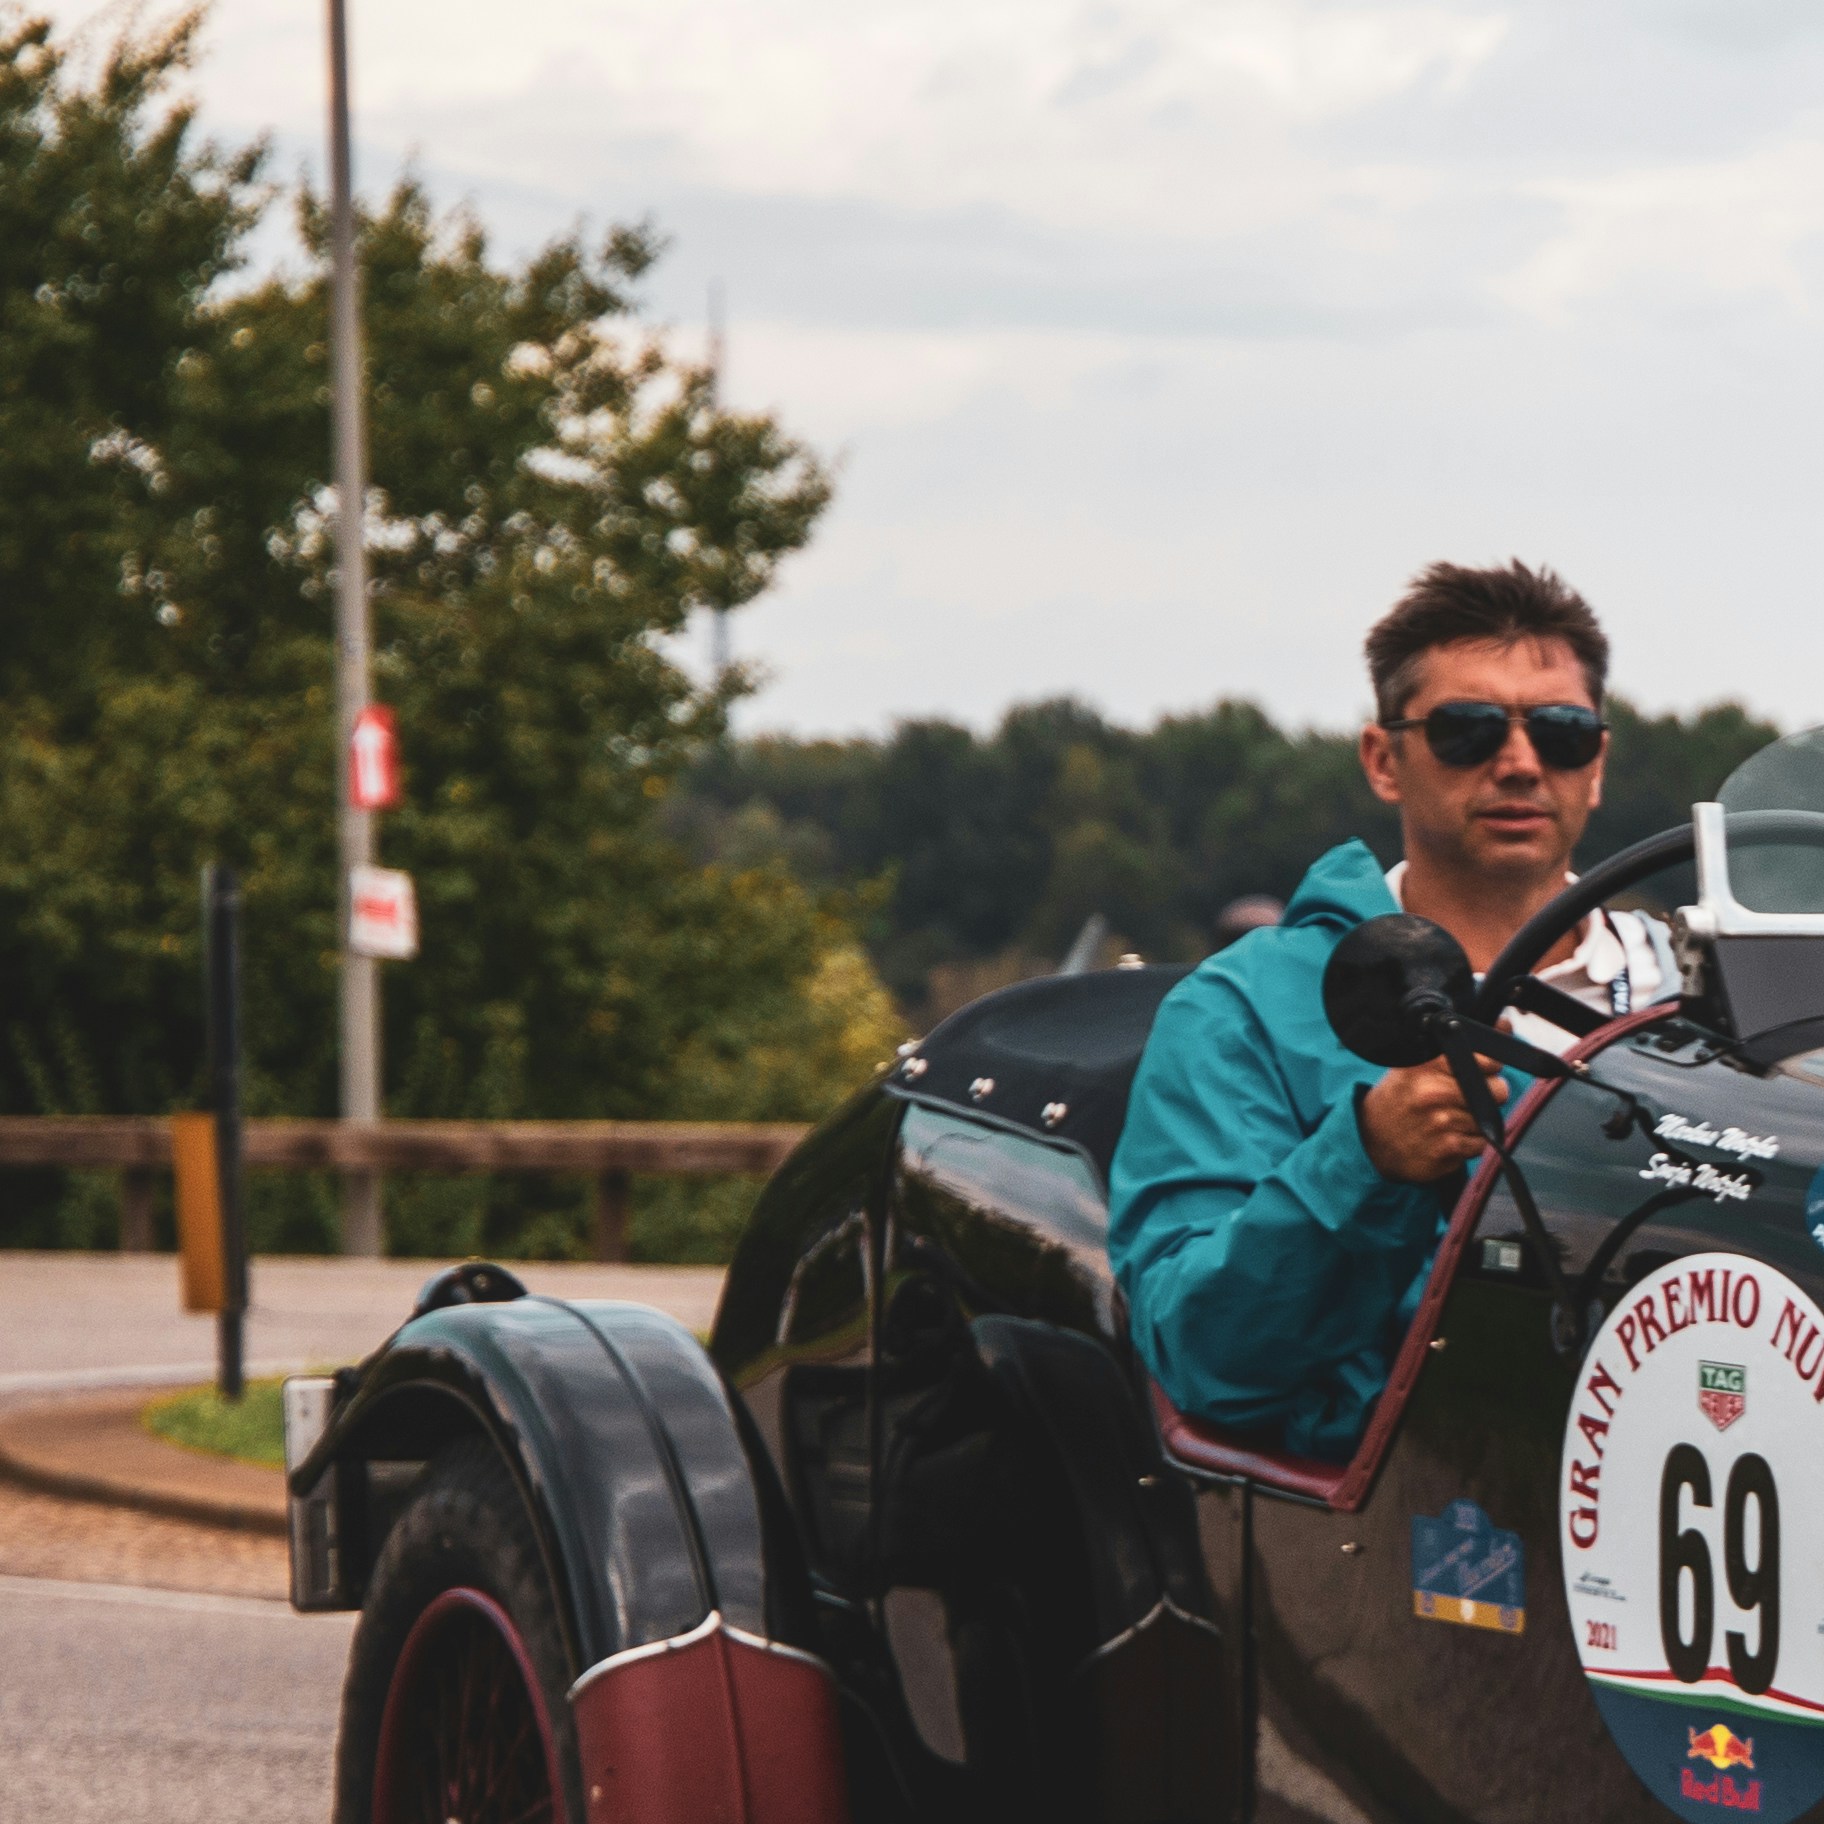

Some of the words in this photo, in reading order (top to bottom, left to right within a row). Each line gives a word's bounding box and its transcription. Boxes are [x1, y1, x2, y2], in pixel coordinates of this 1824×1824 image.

[1703, 1368, 1742, 1391] TAG
[1569, 1361, 1623, 1550] GRAN
[1614, 1268, 1760, 1372] PREMIO
[1659, 1442, 1780, 1695] 69
[1587, 1619, 1617, 1650] 2021
[1681, 1768, 1719, 1804] Red
[1722, 1775, 1761, 1811] Bull
